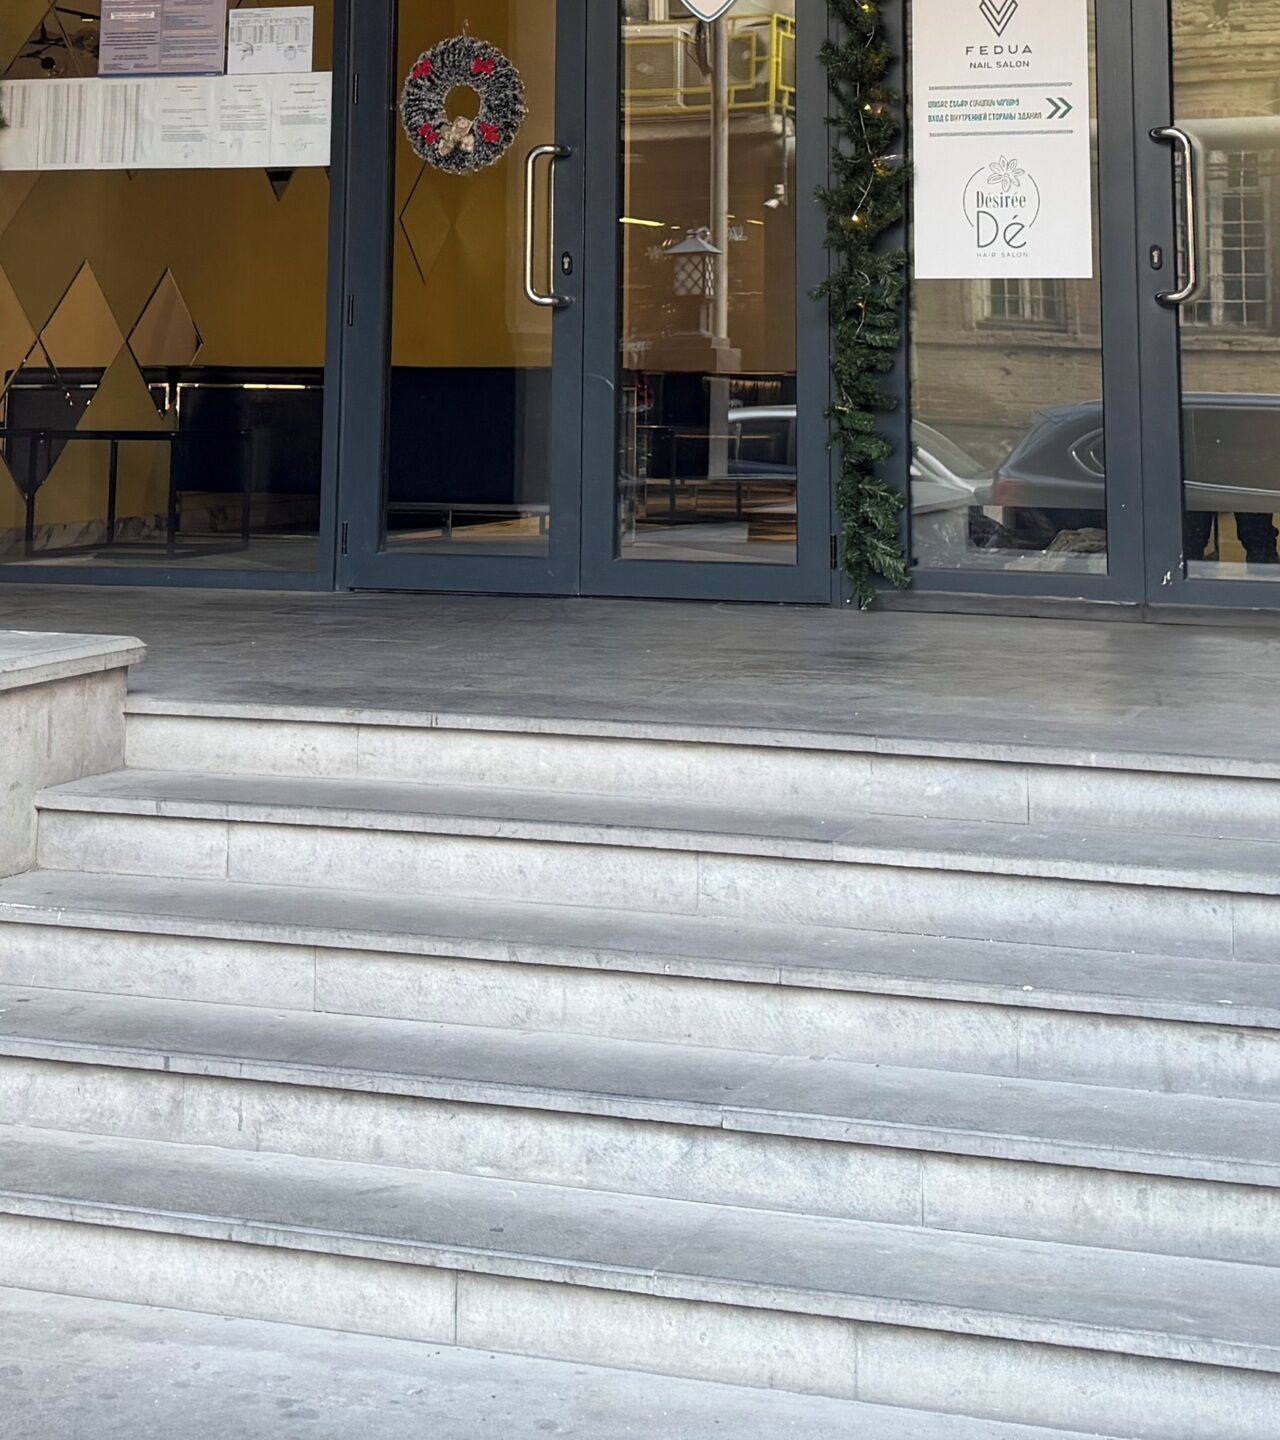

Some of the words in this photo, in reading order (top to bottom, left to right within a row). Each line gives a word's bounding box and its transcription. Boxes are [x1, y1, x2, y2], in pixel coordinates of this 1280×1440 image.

[965, 44, 1033, 56] FEDUA
[969, 61, 993, 70] NAIL
[996, 60, 1030, 69] SALON
[927, 114, 944, 123] ВХОД
[950, 112, 987, 122] ВНУТРЕННЕЙ
[1018, 111, 1042, 121] ЗДАНИЯ
[976, 191, 1027, 208] Désirée
[976, 211, 1027, 249] Dé
